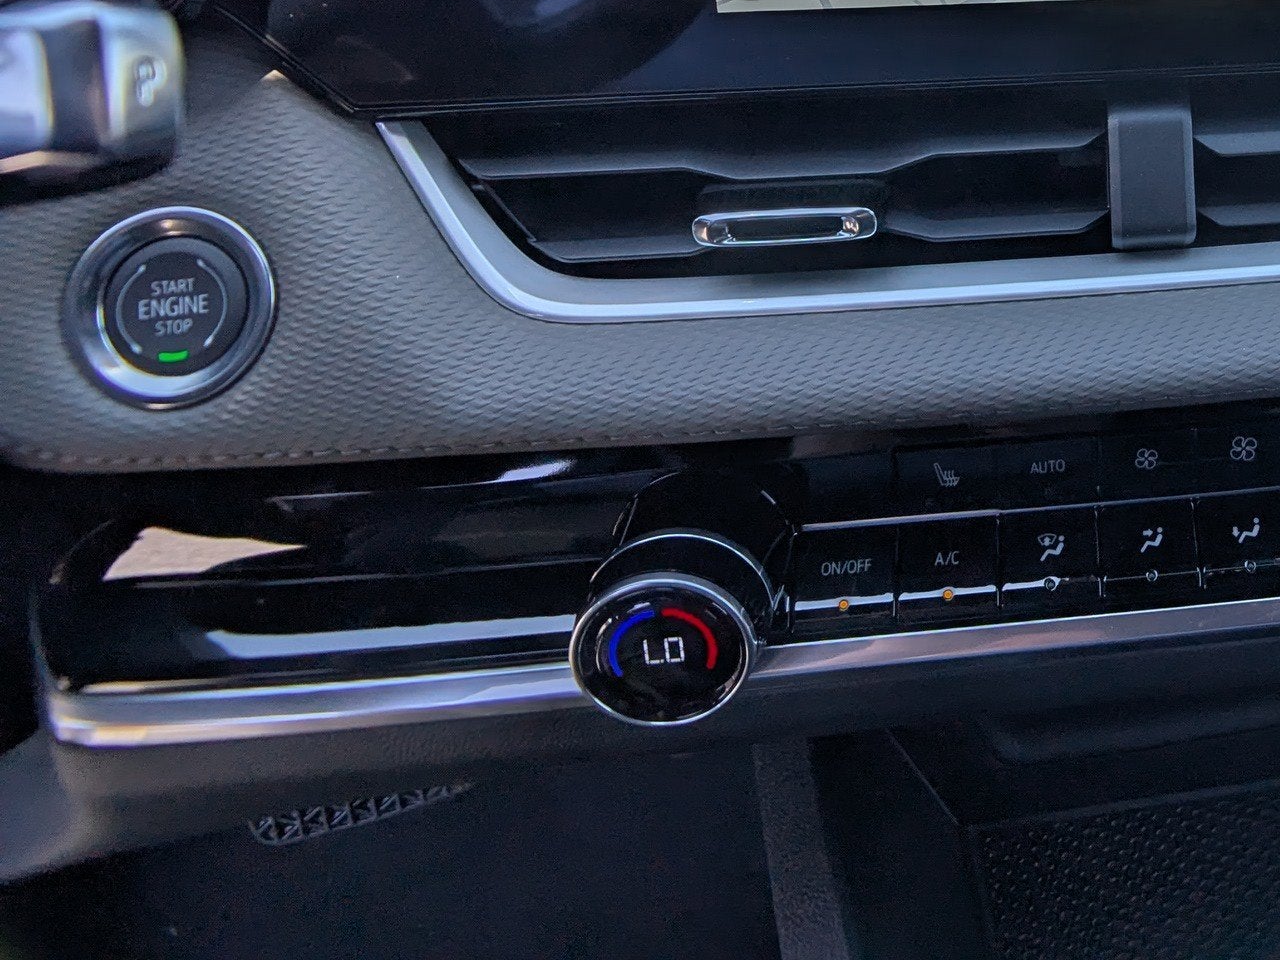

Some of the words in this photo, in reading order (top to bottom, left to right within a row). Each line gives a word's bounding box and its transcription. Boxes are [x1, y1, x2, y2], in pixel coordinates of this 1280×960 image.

[134, 55, 167, 107] P
[1030, 459, 1066, 475] AUTO
[934, 550, 960, 566] A/C
[821, 558, 872, 577] ON/OFF
